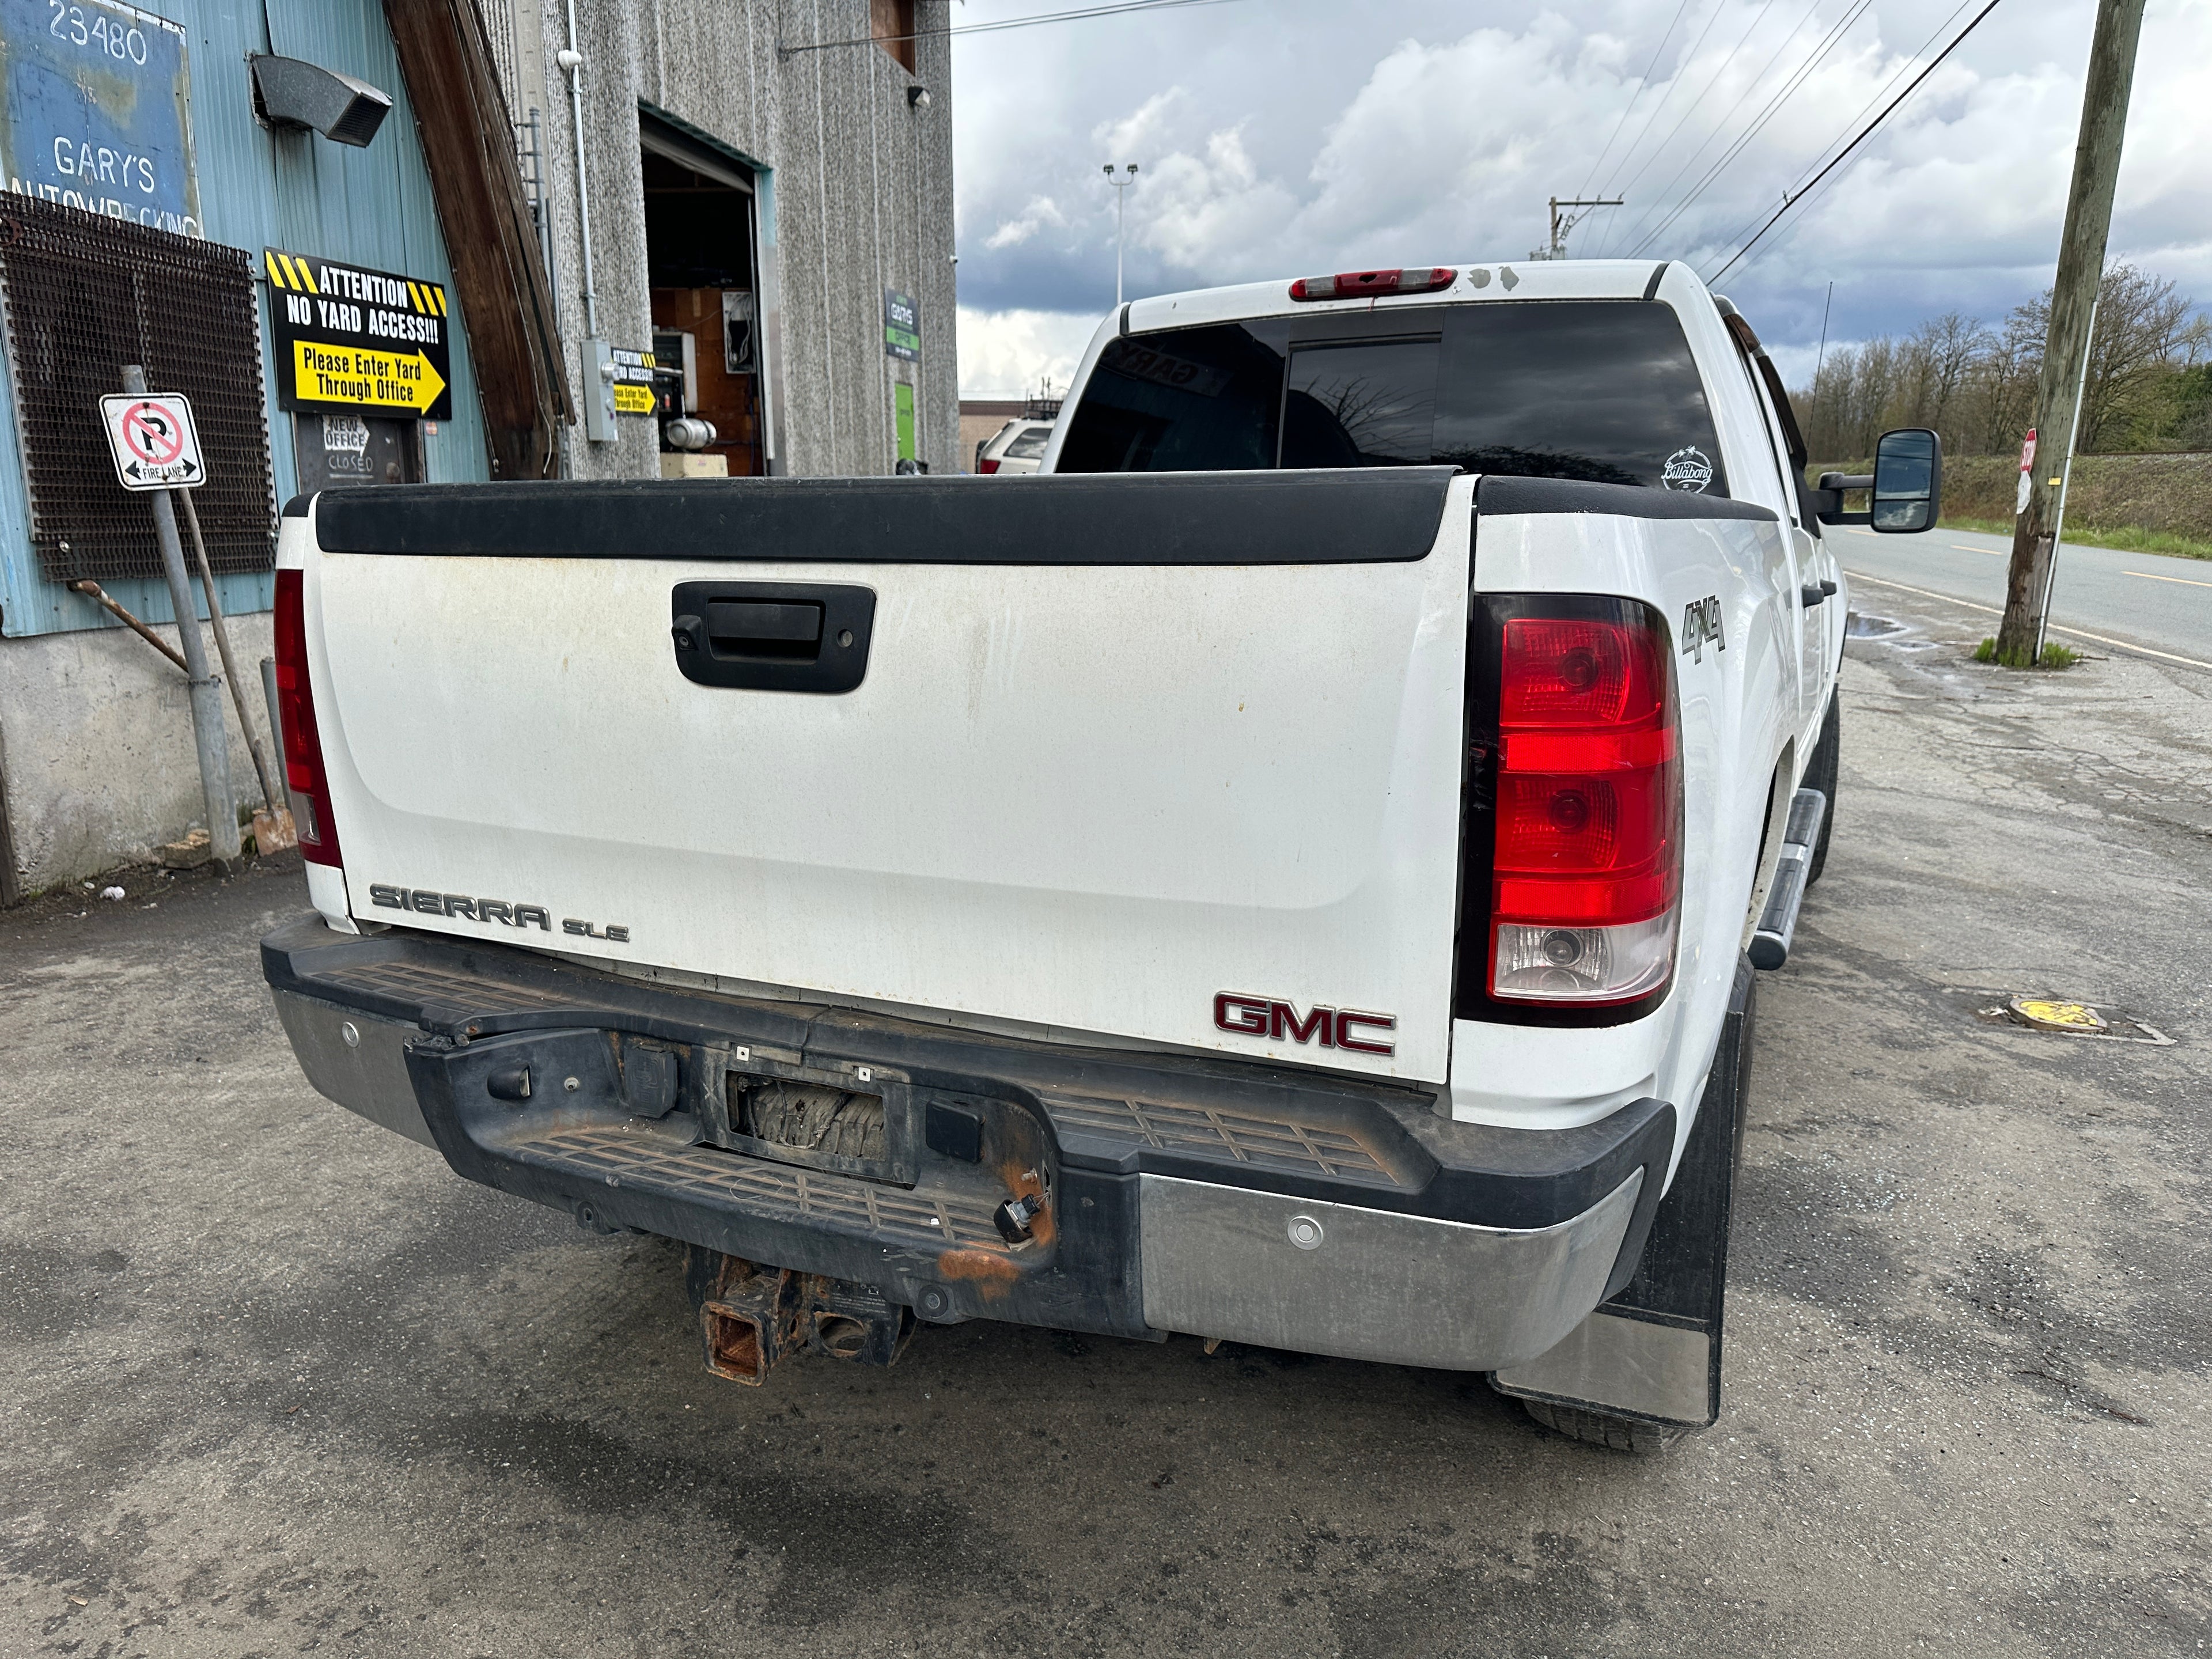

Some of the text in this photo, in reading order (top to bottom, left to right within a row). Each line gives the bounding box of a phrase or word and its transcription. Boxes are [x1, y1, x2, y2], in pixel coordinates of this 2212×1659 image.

[50, 0, 146, 65] 23480
[54, 137, 154, 193] GARY'S
[320, 265, 408, 308] ATTENTION
[286, 294, 439, 344] NO YARD ACCESS!!!
[304, 347, 421, 380] Please Enter Yard
[612, 350, 642, 366] ATTENTION
[316, 373, 414, 402] Through Office
[625, 387, 637, 398] Enter
[638, 389, 648, 400] Yard
[632, 399, 646, 410] Office
[329, 416, 358, 432] NEW
[325, 430, 366, 448] OFFICE
[2021, 440, 2036, 467] STOP
[142, 465, 182, 479] FIRE LANE
[1661, 461, 1713, 485] Billabong
[369, 882, 630, 943] SIERRA SLE
[1213, 990, 1397, 1058] GMC
